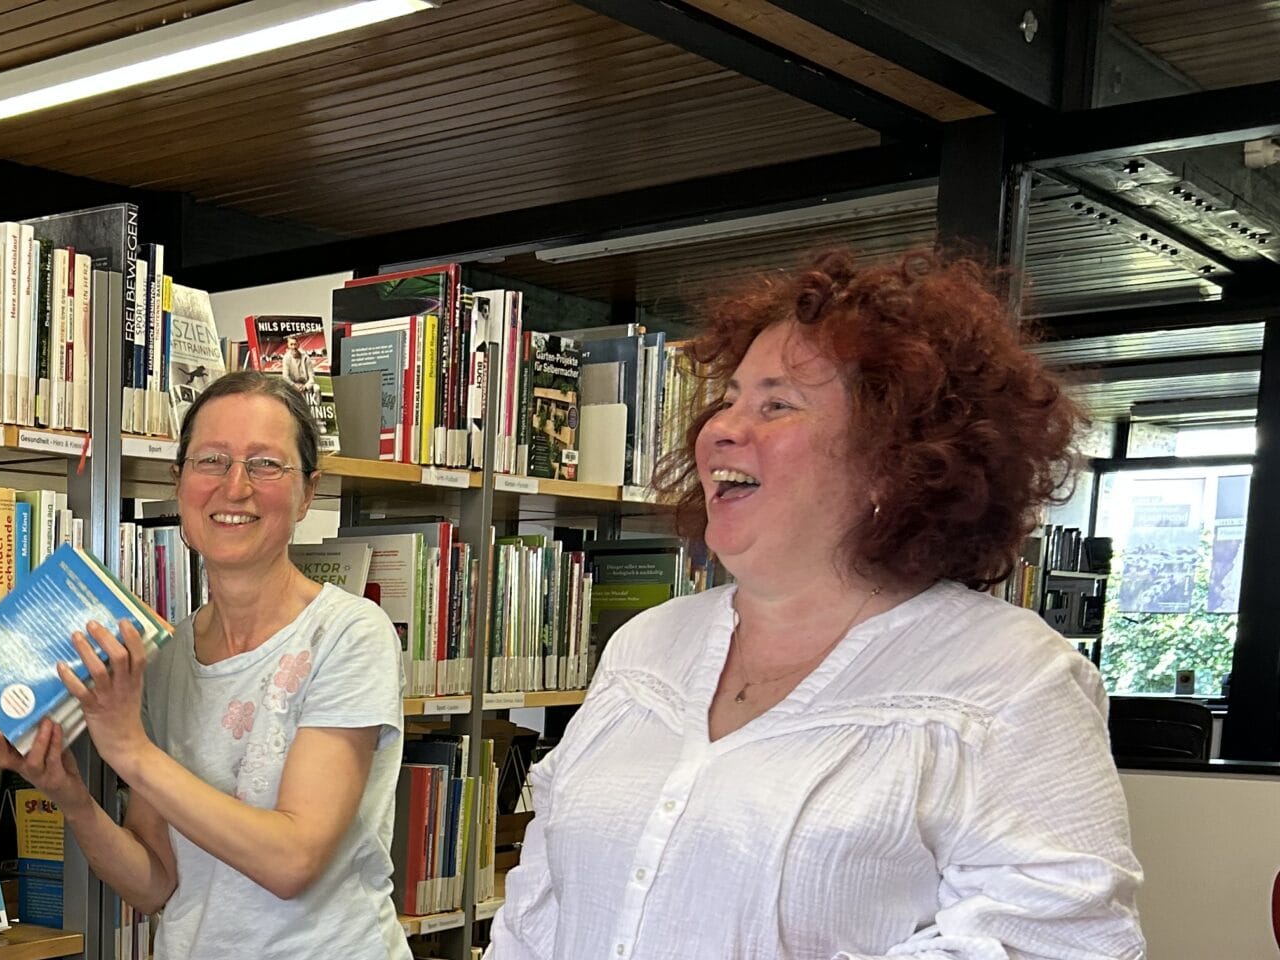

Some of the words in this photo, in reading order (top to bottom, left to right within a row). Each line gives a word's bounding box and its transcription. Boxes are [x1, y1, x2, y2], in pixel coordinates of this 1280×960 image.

[125, 307, 136, 342] FREI
[135, 304, 143, 336] SPORT
[258, 322, 279, 333] NILS
[281, 321, 322, 333] PETERSEN
[544, 362, 579, 379] Selbermacher
[21, 434, 49, 445] Gesundheit
